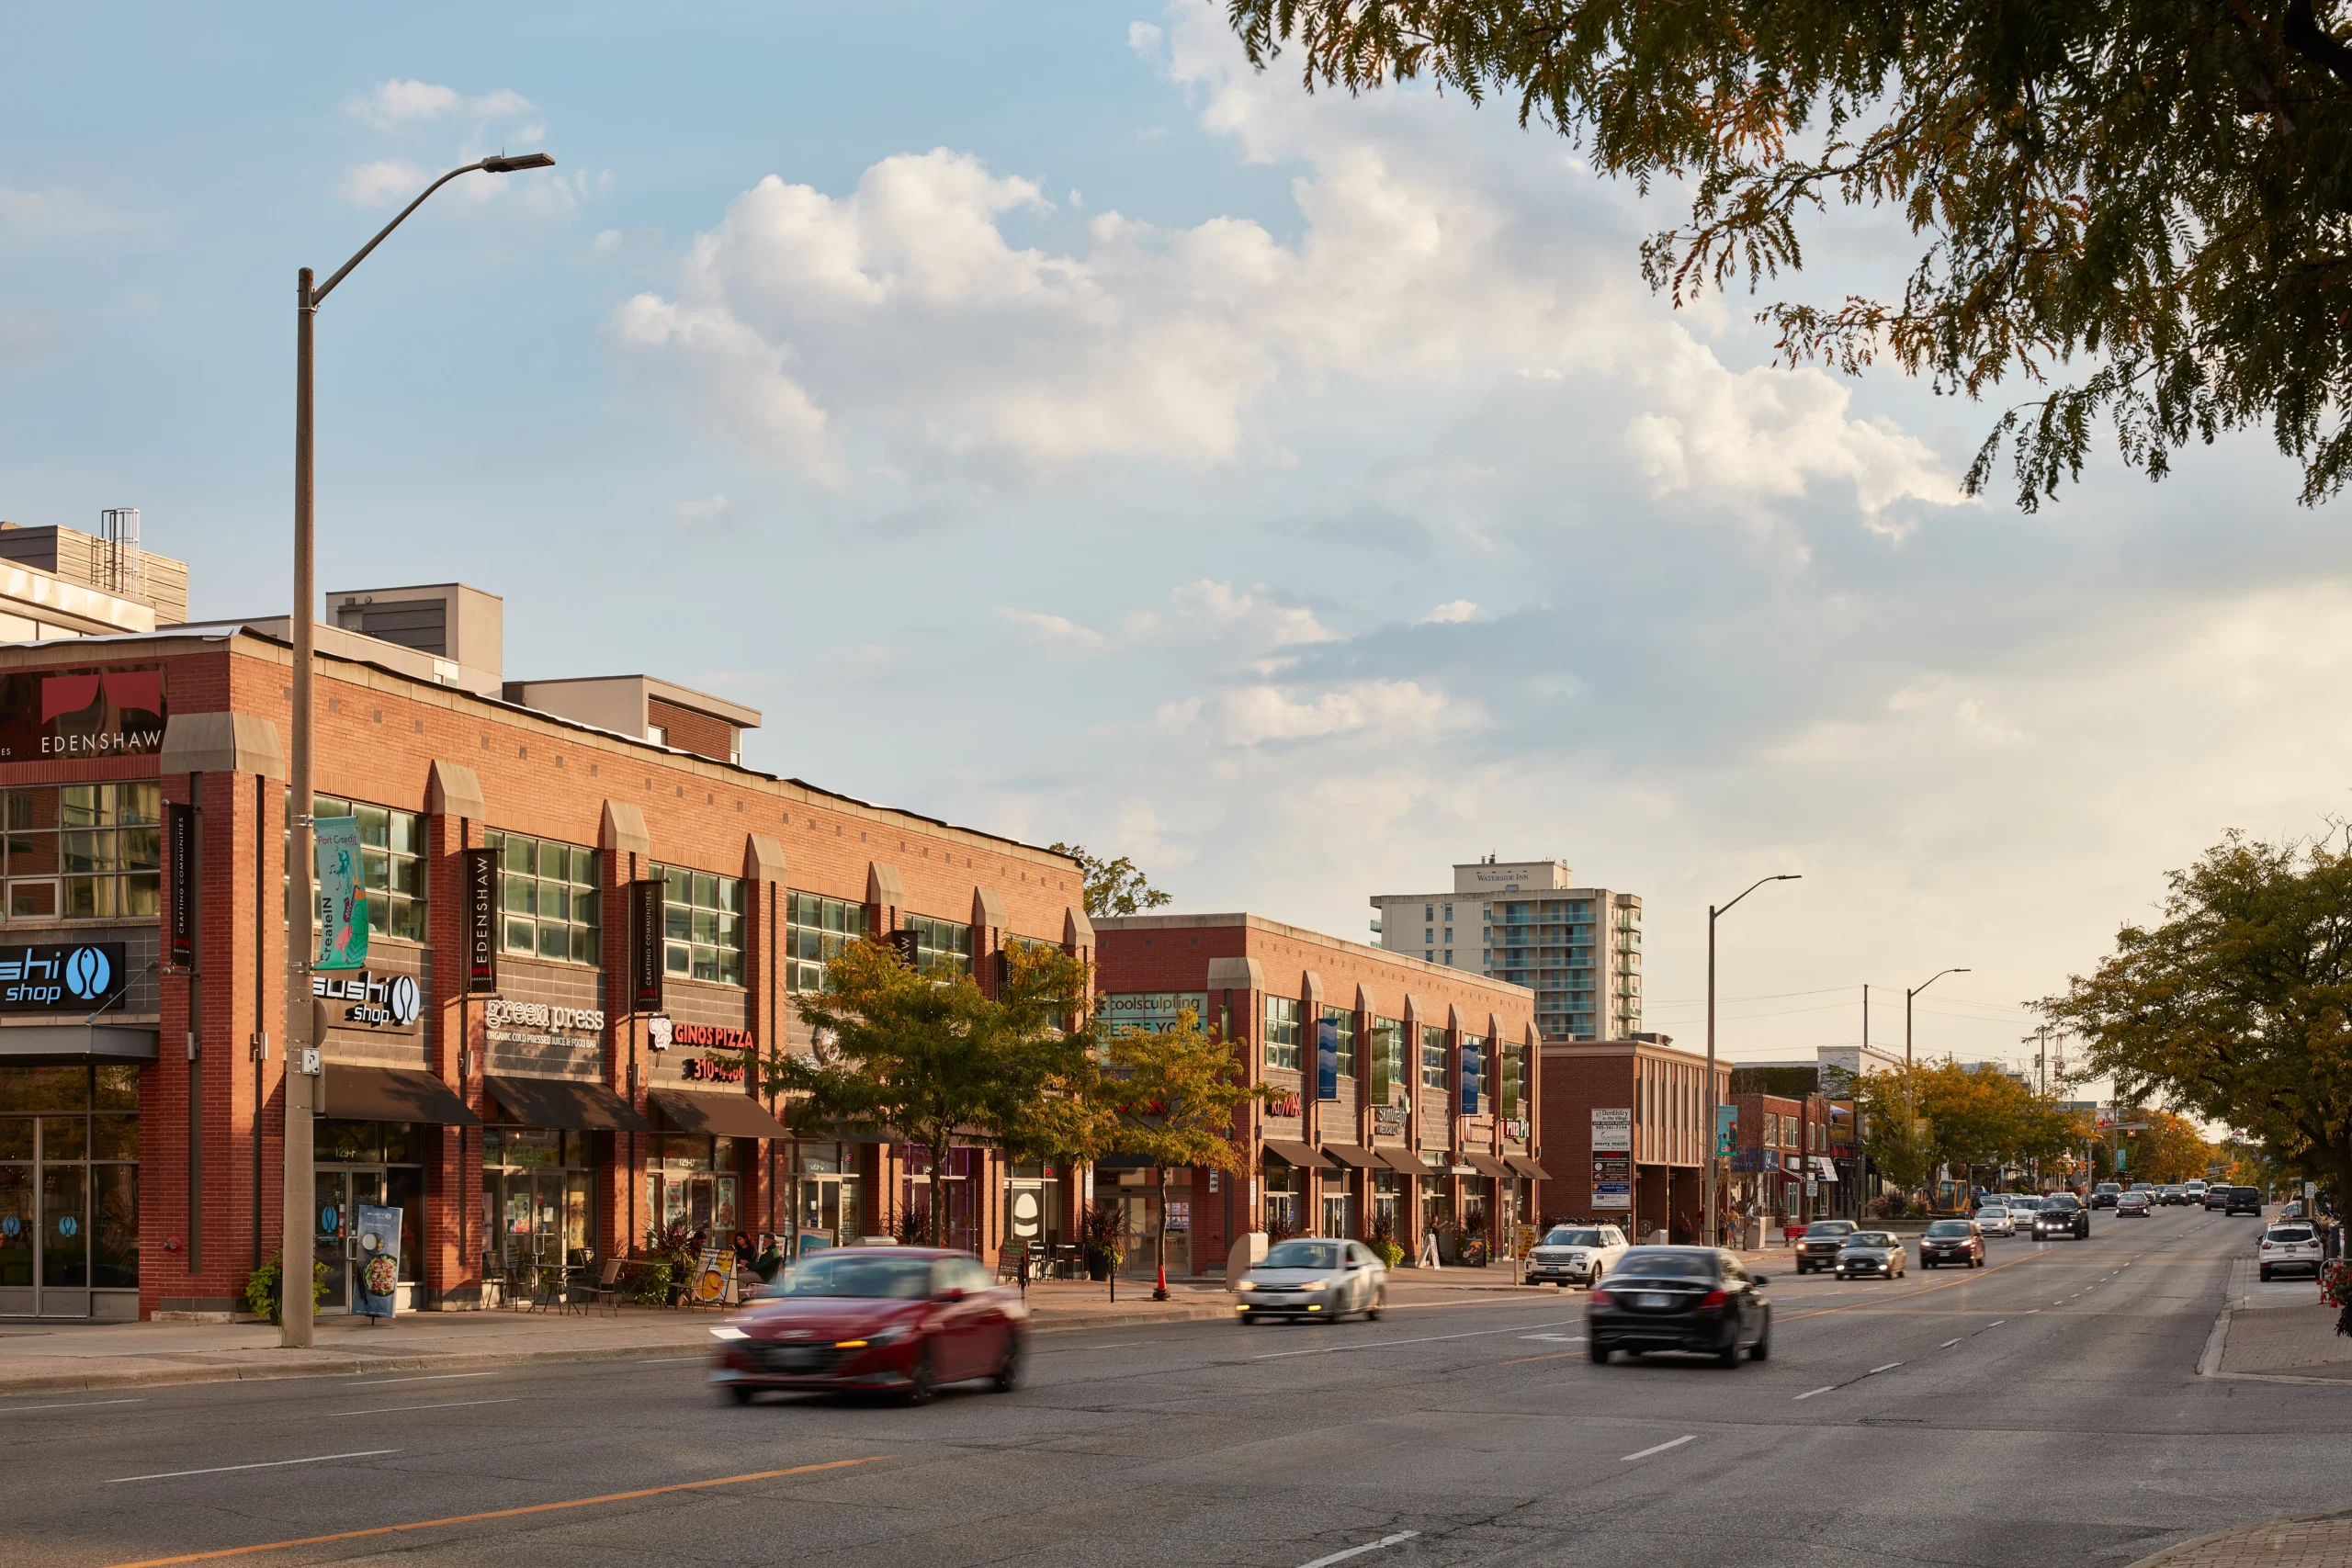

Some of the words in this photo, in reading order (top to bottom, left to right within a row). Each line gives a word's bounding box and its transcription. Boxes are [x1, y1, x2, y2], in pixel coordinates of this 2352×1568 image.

[41, 730, 161, 753] EDENSHAW
[318, 836, 333, 845] Port
[334, 834, 357, 845] Credit
[476, 857, 488, 963] EDENSHAW
[6, 983, 62, 1005] shop
[313, 970, 390, 1003] sushi
[354, 1003, 390, 1026] shop
[1110, 995, 1200, 1012] coolsculpting
[486, 998, 549, 1029] green
[548, 1006, 605, 1033] press
[486, 1030, 512, 1042] ORGANIC
[512, 1032, 526, 1043] COLD
[527, 1033, 551, 1045] PRESSED
[551, 1036, 566, 1046] JUICE
[566, 1039, 571, 1047] &
[571, 1039, 586, 1048] FOOD
[586, 1040, 597, 1049] BAR
[675, 1023, 713, 1045] GINOS
[715, 1028, 754, 1049] PIZZA
[1156, 1021, 1202, 1036] YOR
[1507, 1118, 1520, 1137] Pita
[1520, 1120, 1530, 1138] Pit
